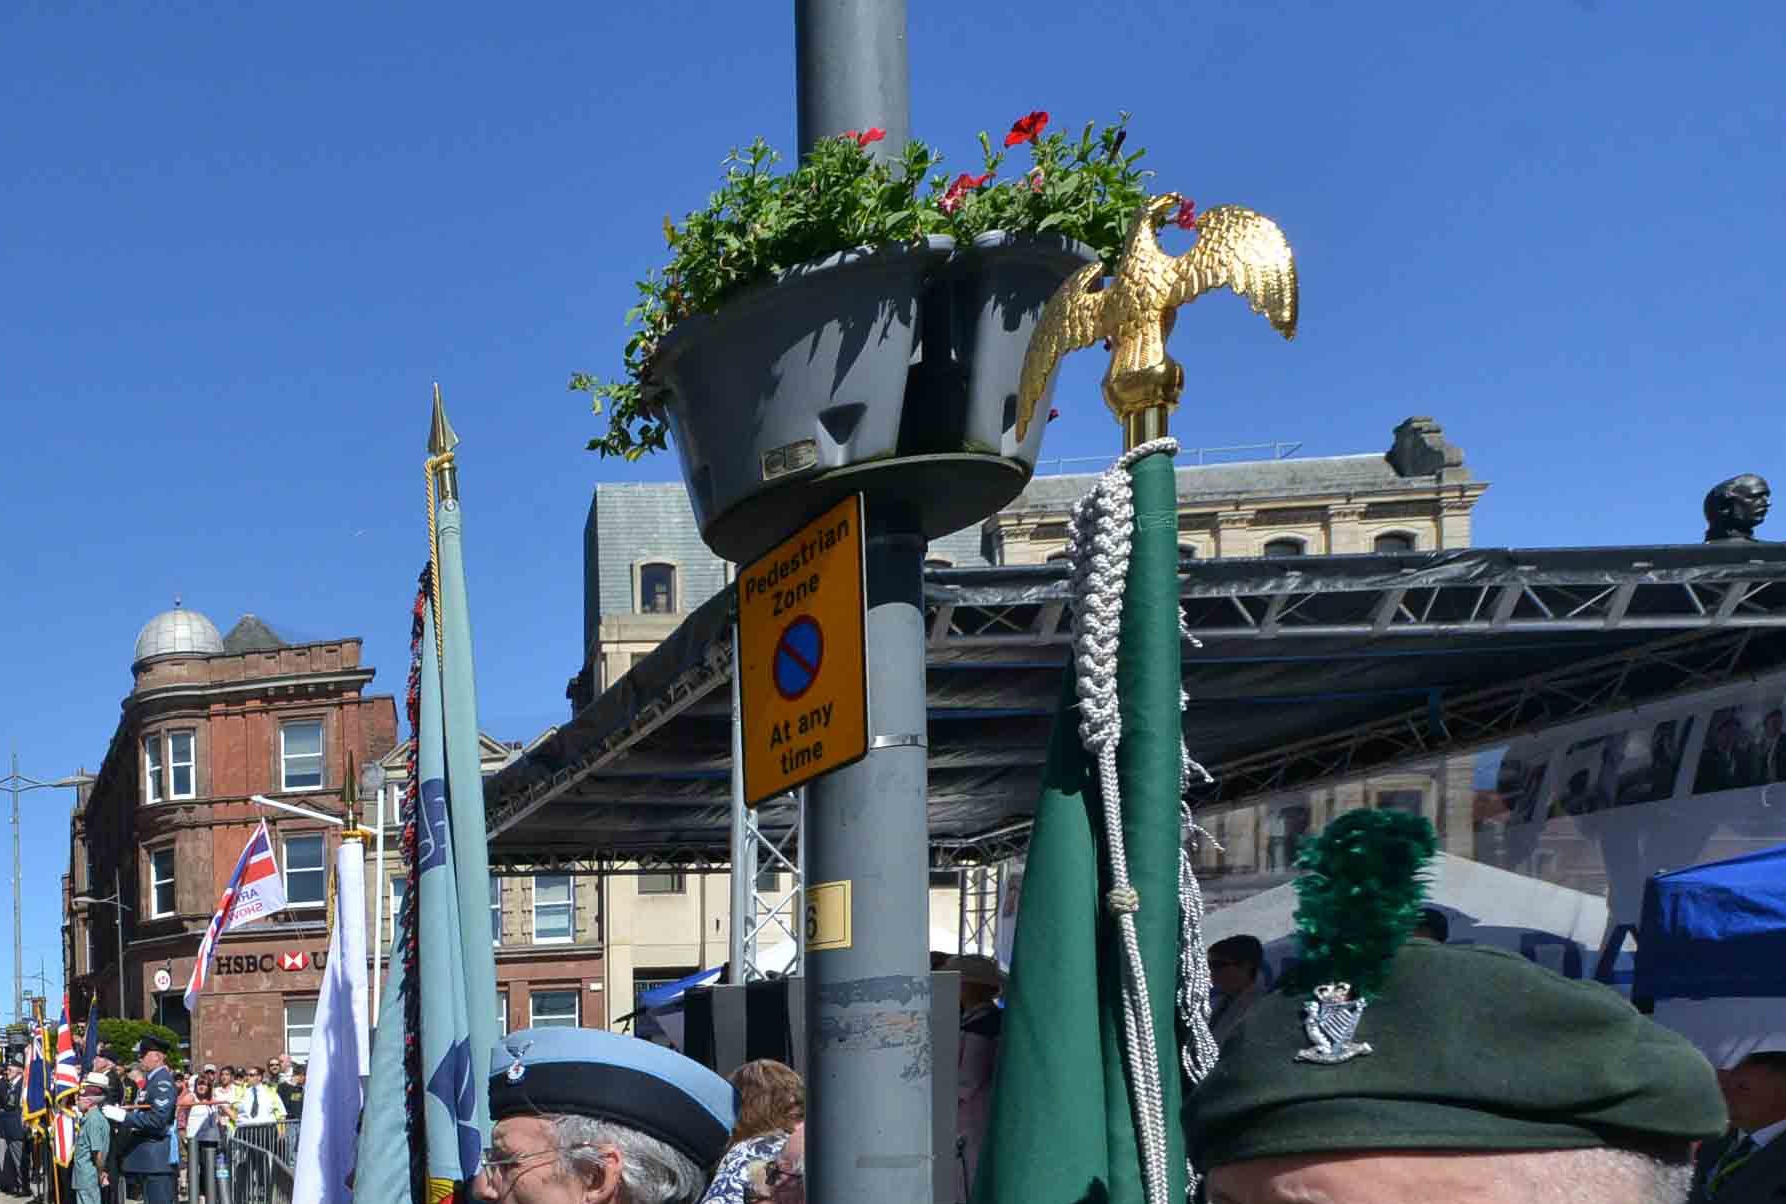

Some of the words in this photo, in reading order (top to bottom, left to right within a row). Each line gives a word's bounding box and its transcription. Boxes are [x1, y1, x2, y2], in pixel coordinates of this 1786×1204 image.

[745, 519, 849, 602] Pedestrian
[773, 572, 820, 617] Zone
[770, 722, 791, 750] At
[798, 700, 833, 734] any
[781, 741, 823, 776] time
[215, 954, 275, 975] HSBC
